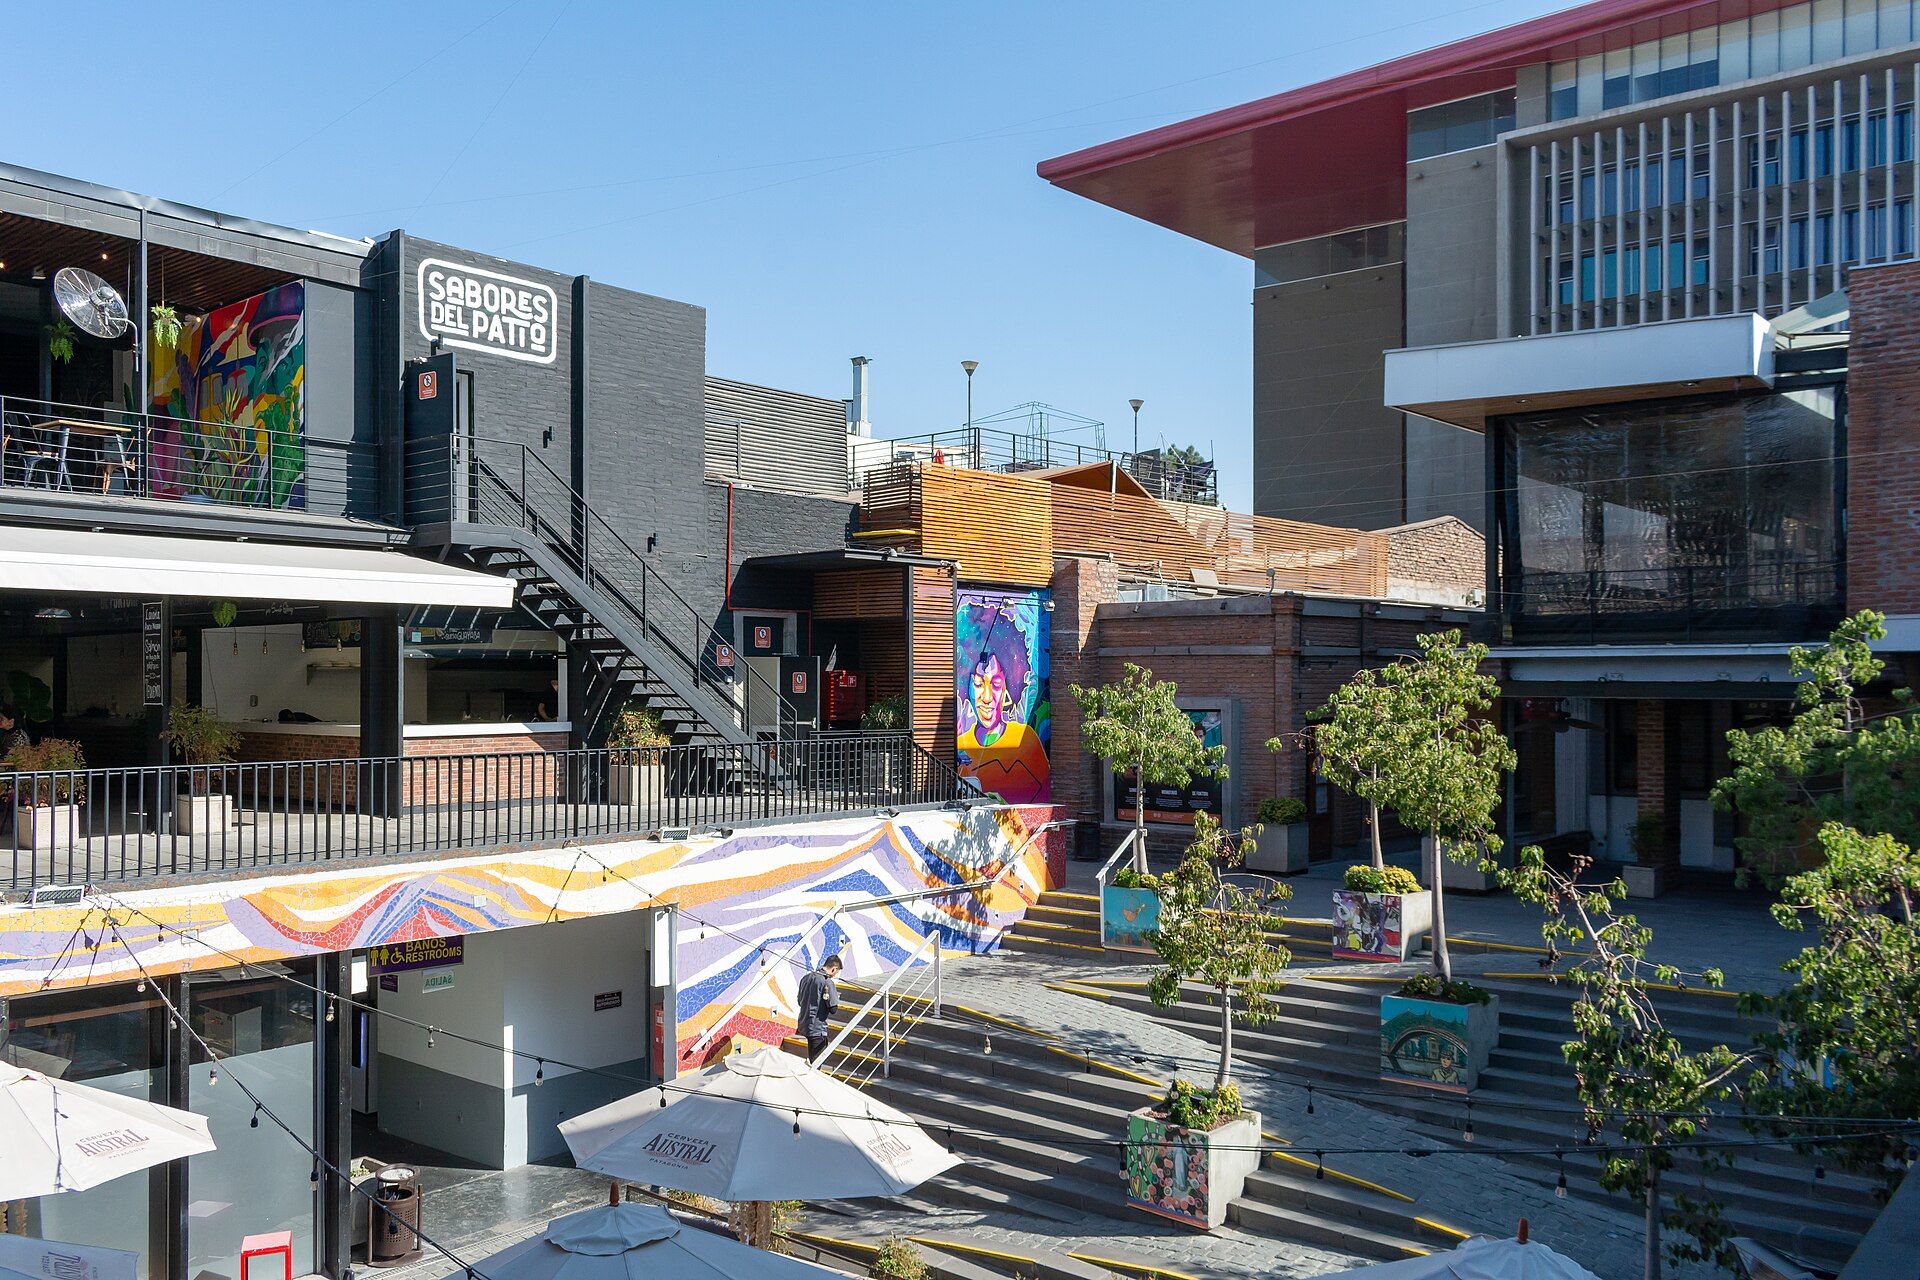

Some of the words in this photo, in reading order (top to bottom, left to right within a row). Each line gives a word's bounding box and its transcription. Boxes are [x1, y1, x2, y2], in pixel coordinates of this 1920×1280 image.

[428, 271, 549, 324] SABORES
[430, 300, 469, 337] DEL
[472, 309, 546, 353] PATIO
[406, 946, 462, 963] RESTROOMS
[75, 1128, 151, 1157] AUSTRAL
[79, 1129, 121, 1143] CERVEZA
[667, 1132, 709, 1146] CERVEZA
[641, 1133, 717, 1164] AUSTRAL
[648, 1157, 689, 1170] PATAGONIA
